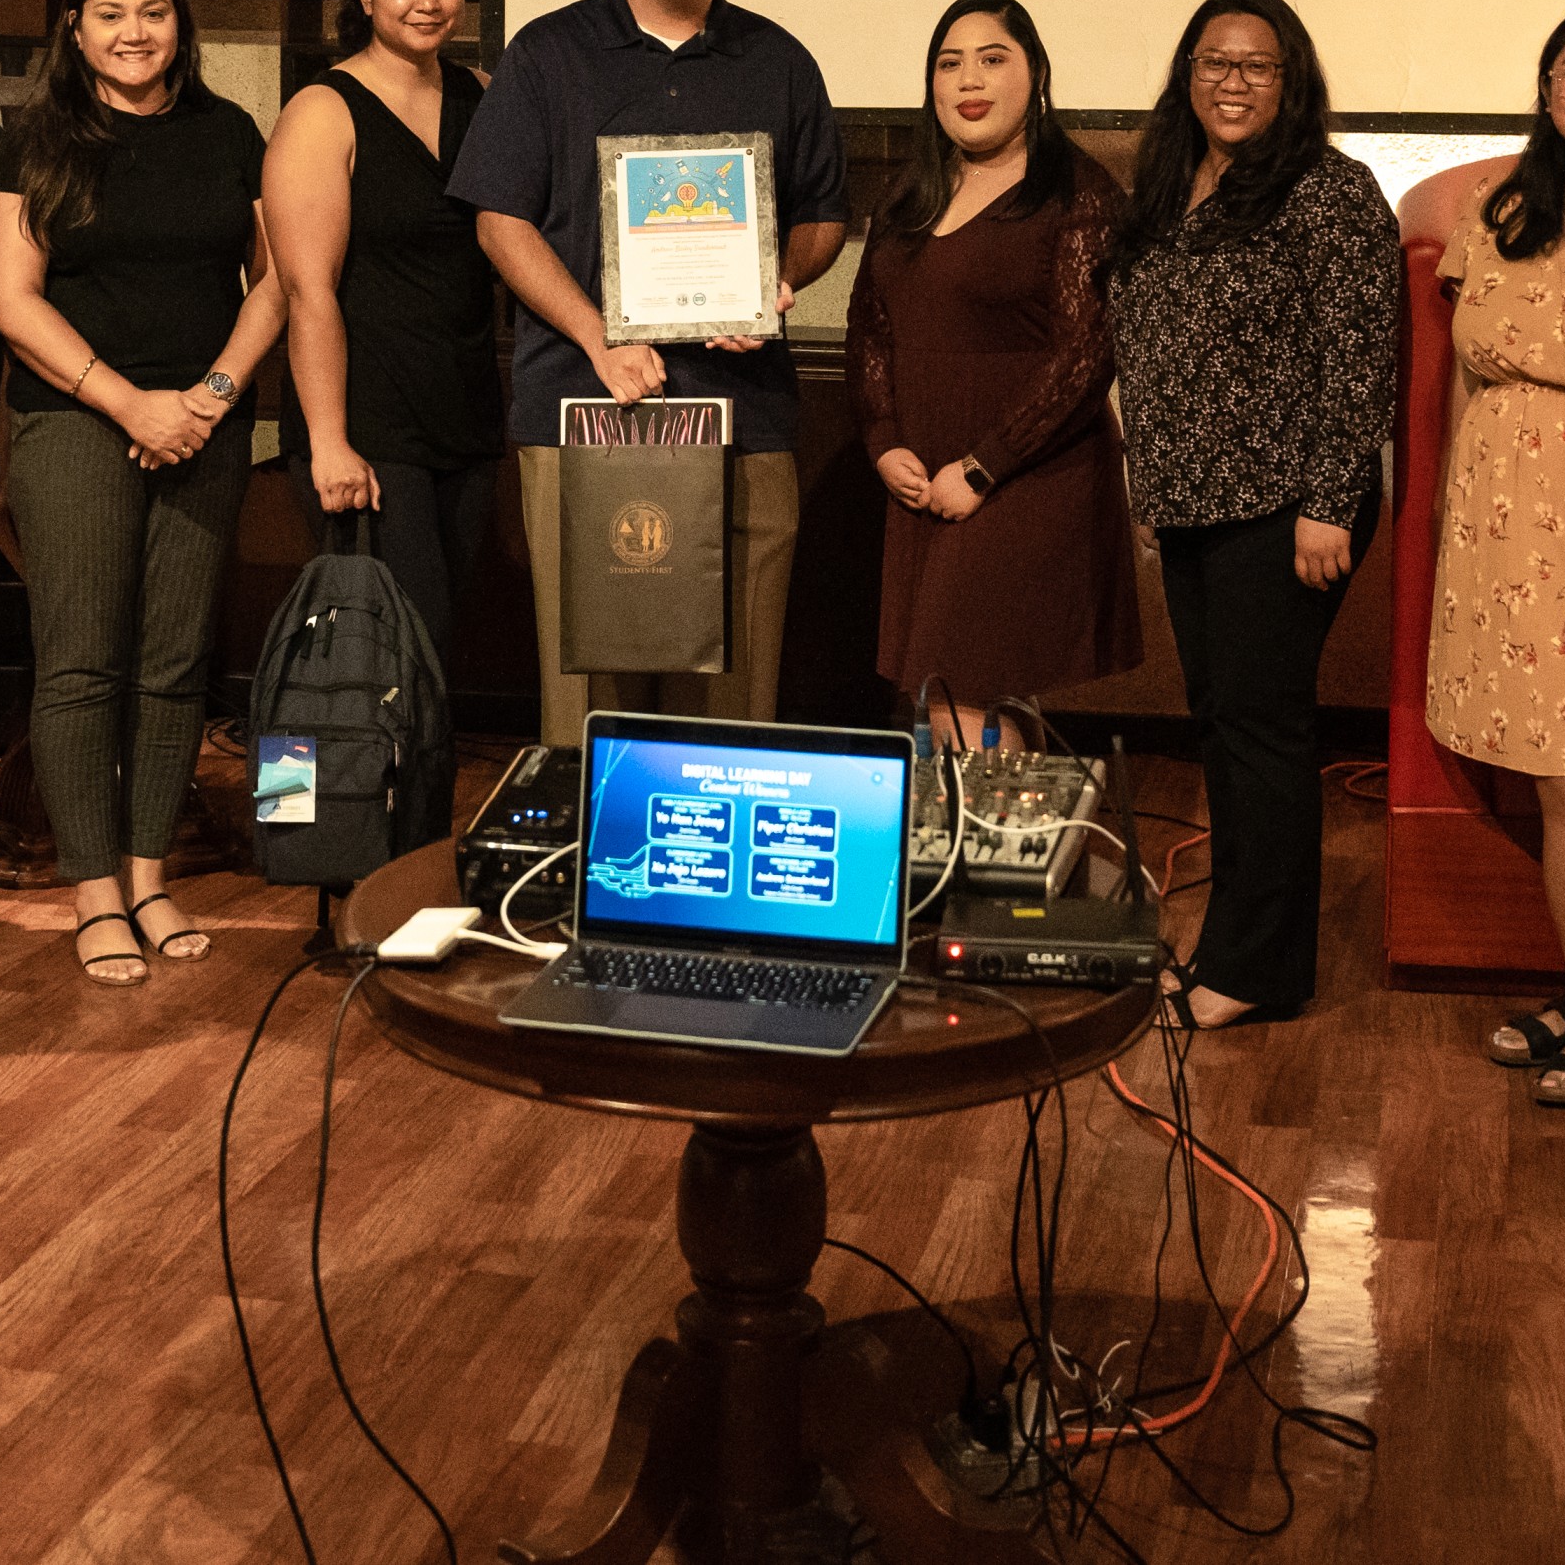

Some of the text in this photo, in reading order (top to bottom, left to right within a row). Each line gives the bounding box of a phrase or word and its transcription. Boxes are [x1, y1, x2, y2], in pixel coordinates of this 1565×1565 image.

[682, 763, 812, 787] DIGITAL LEARNING DAY
